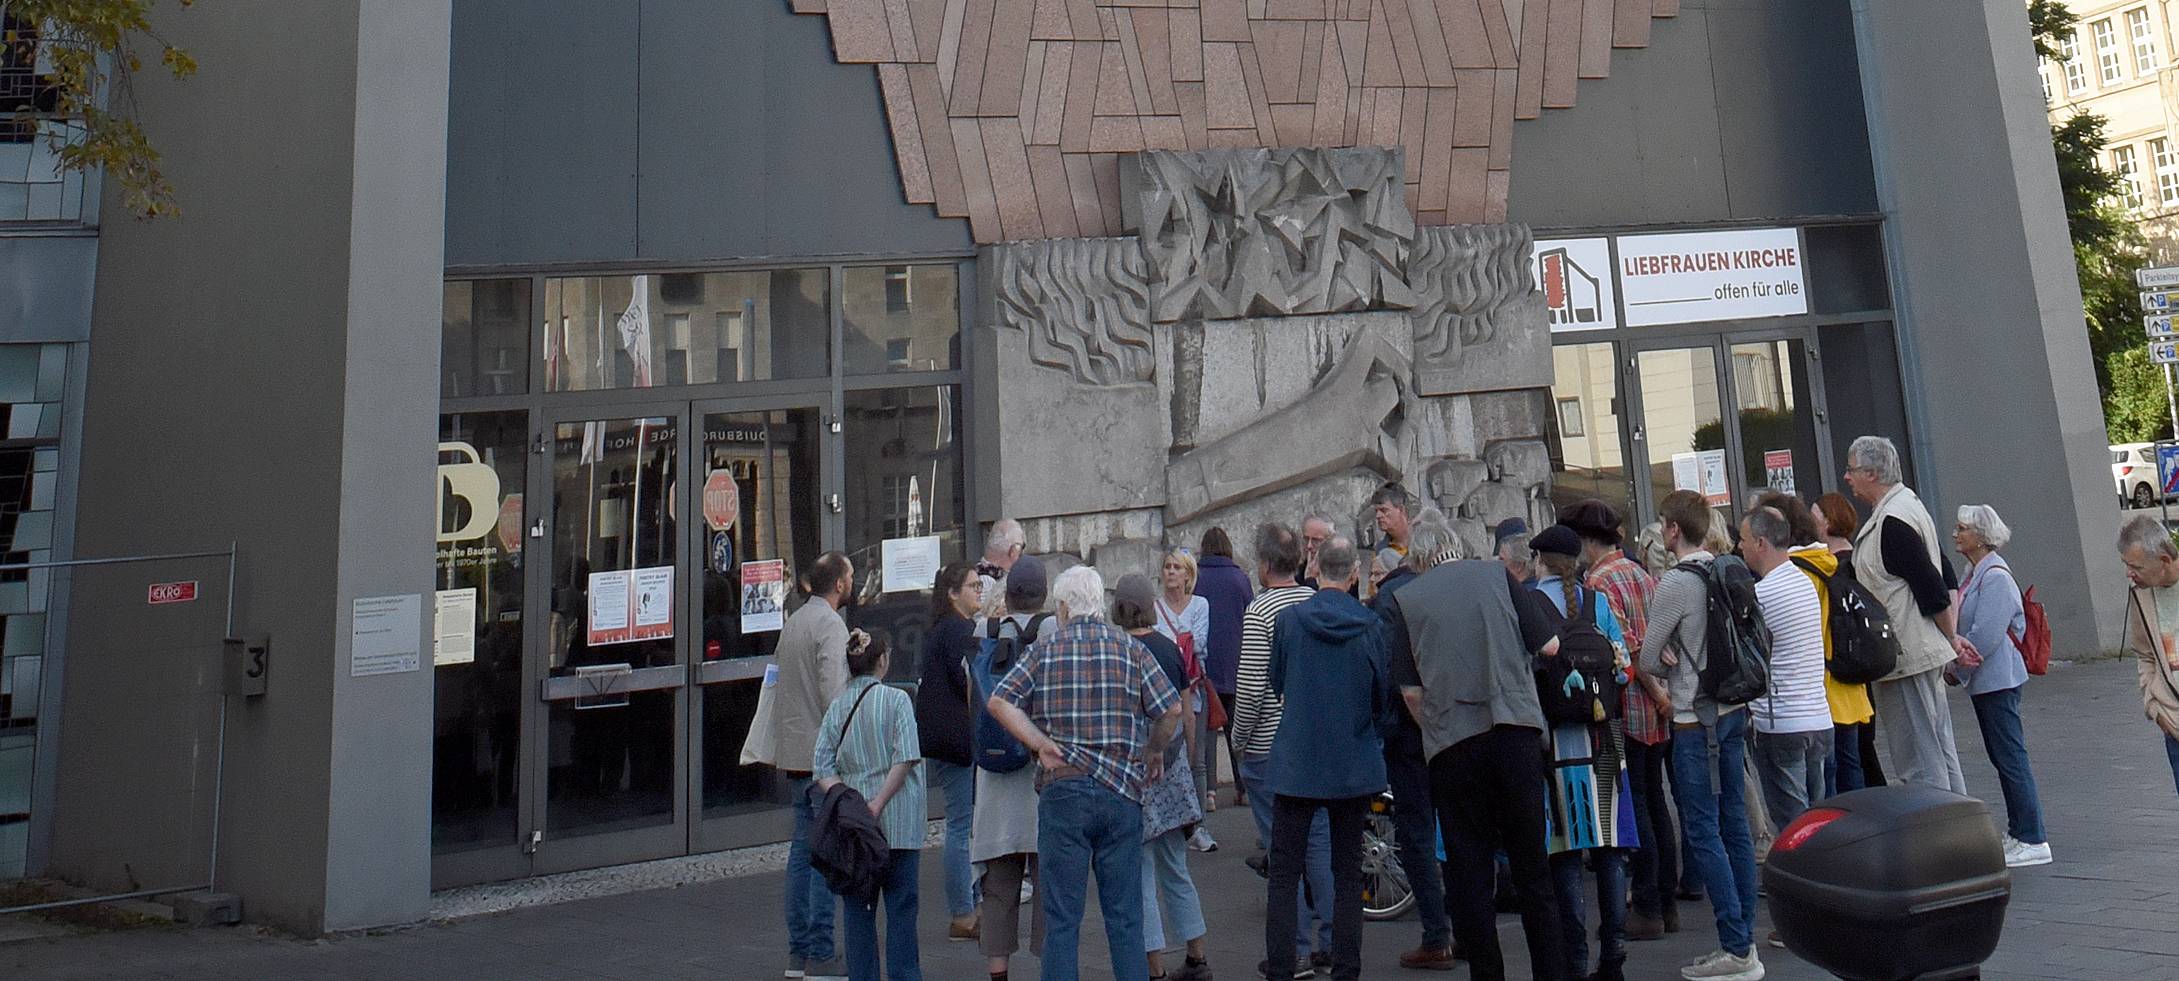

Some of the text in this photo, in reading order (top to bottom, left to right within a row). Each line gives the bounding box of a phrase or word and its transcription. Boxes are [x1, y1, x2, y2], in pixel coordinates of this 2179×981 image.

[1625, 248, 1796, 276] LIEBFRAUEN KIRCHE
[1714, 280, 1799, 300] offen für alle
[466, 546, 497, 557] Bauten
[247, 647, 265, 678] 3
